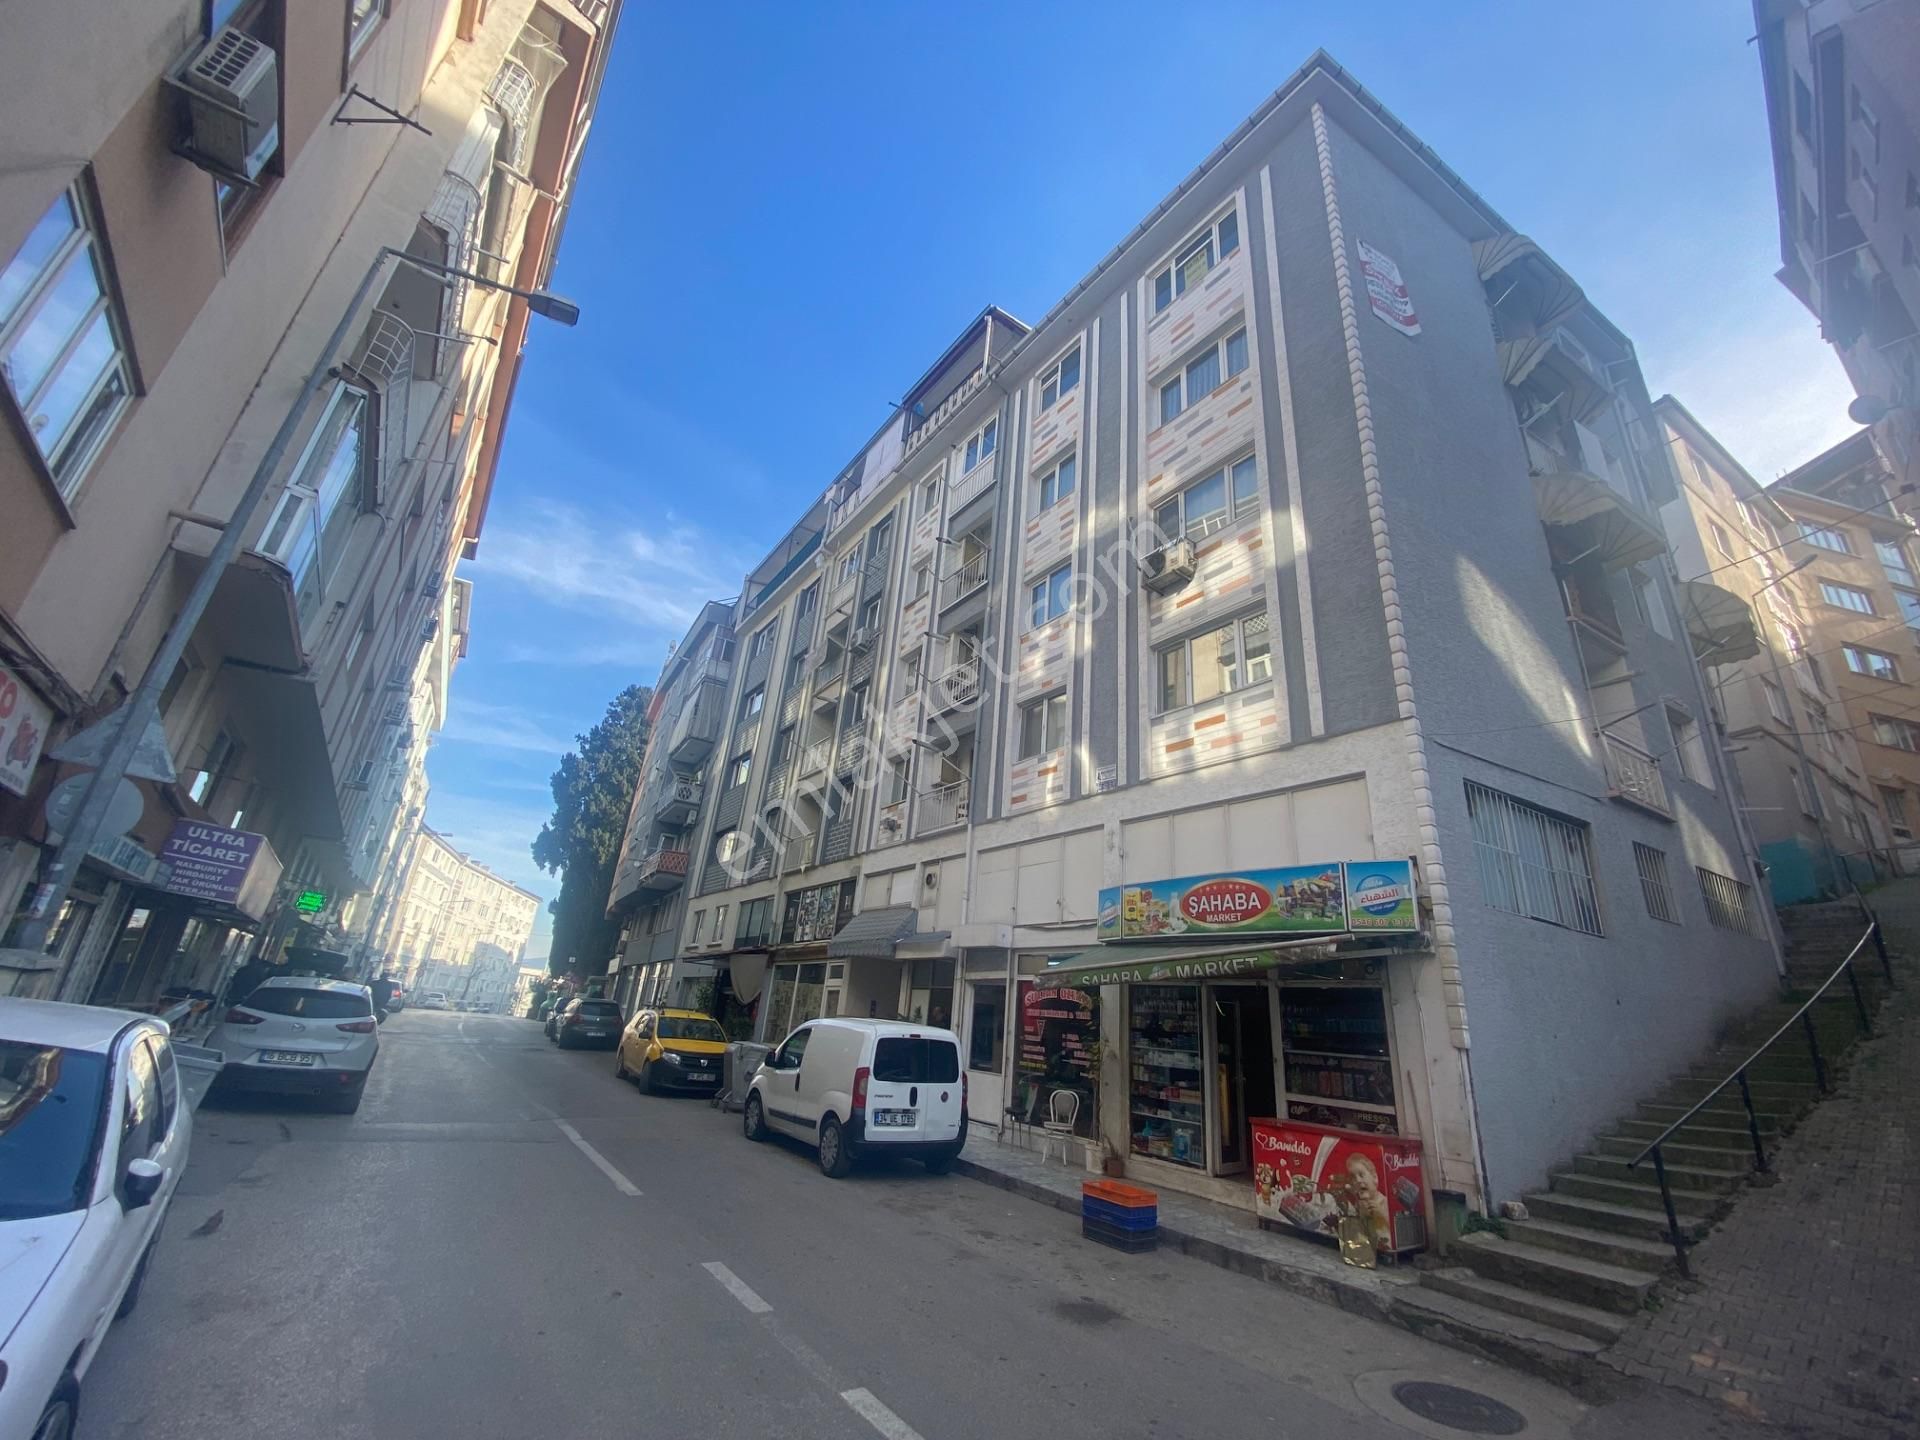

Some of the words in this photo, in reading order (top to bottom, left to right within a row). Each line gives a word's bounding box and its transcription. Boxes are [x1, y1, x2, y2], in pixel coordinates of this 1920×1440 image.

[187, 826, 245, 847] ULTRA
[172, 839, 250, 863] TİCARET
[1188, 892, 1261, 917] ŞAHABA
[1206, 913, 1242, 922] MARKET
